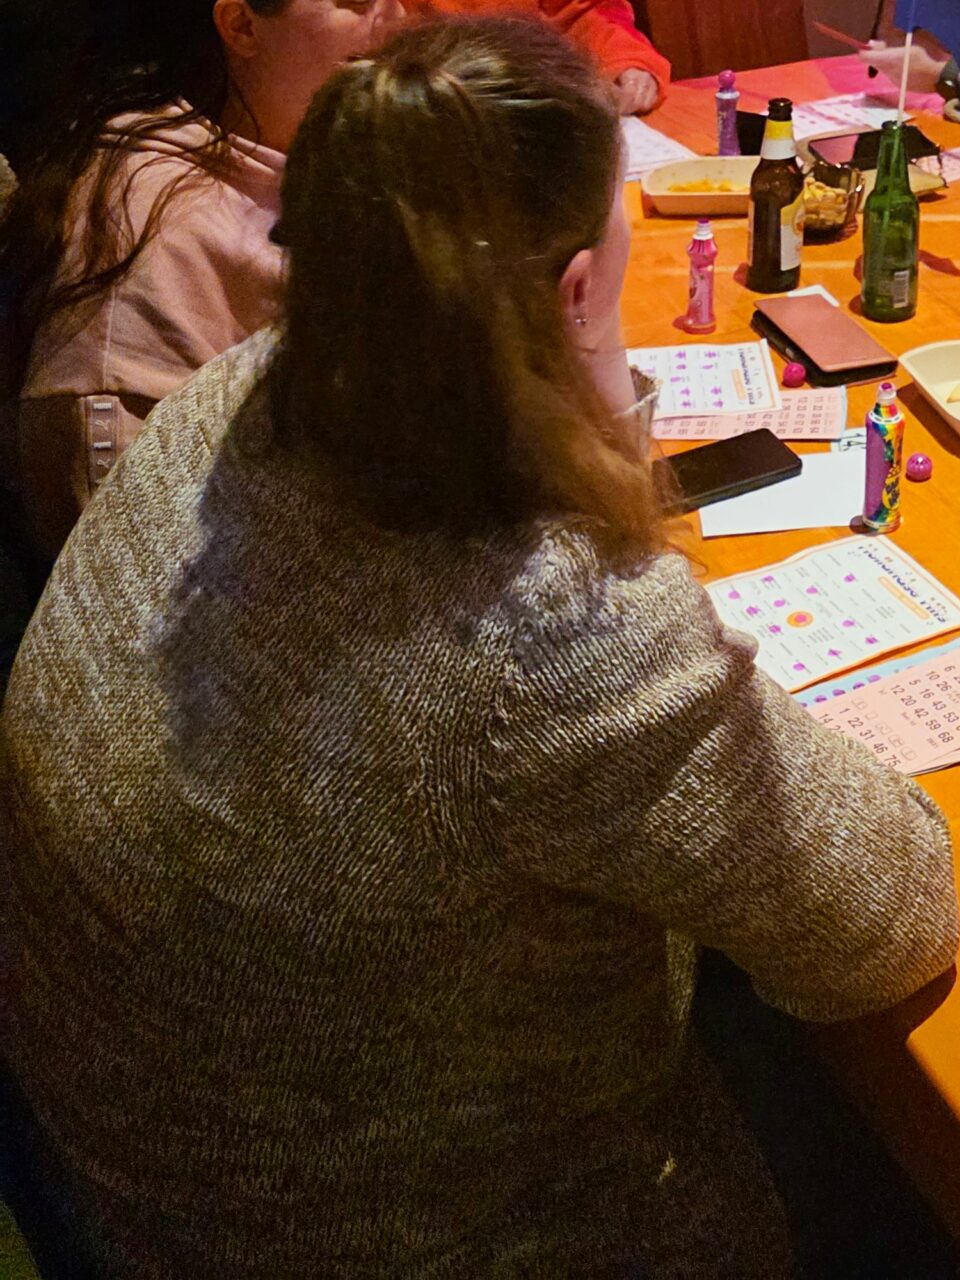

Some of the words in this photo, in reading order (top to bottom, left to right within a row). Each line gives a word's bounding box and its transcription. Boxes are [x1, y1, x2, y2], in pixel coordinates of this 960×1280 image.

[926, 671, 940, 681] 10
[936, 681, 952, 692] 26
[891, 685, 905, 695] 12
[901, 696, 917, 706] 20
[914, 708, 929, 718] 42
[926, 720, 941, 730] 59
[938, 732, 954, 743] 68
[920, 688, 935, 699] 16
[933, 701, 946, 710] 43
[944, 712, 959, 722] 53
[848, 717, 863, 728] 22
[860, 730, 875, 740] 31
[873, 743, 888, 754] 46
[884, 754, 901, 767] 75
